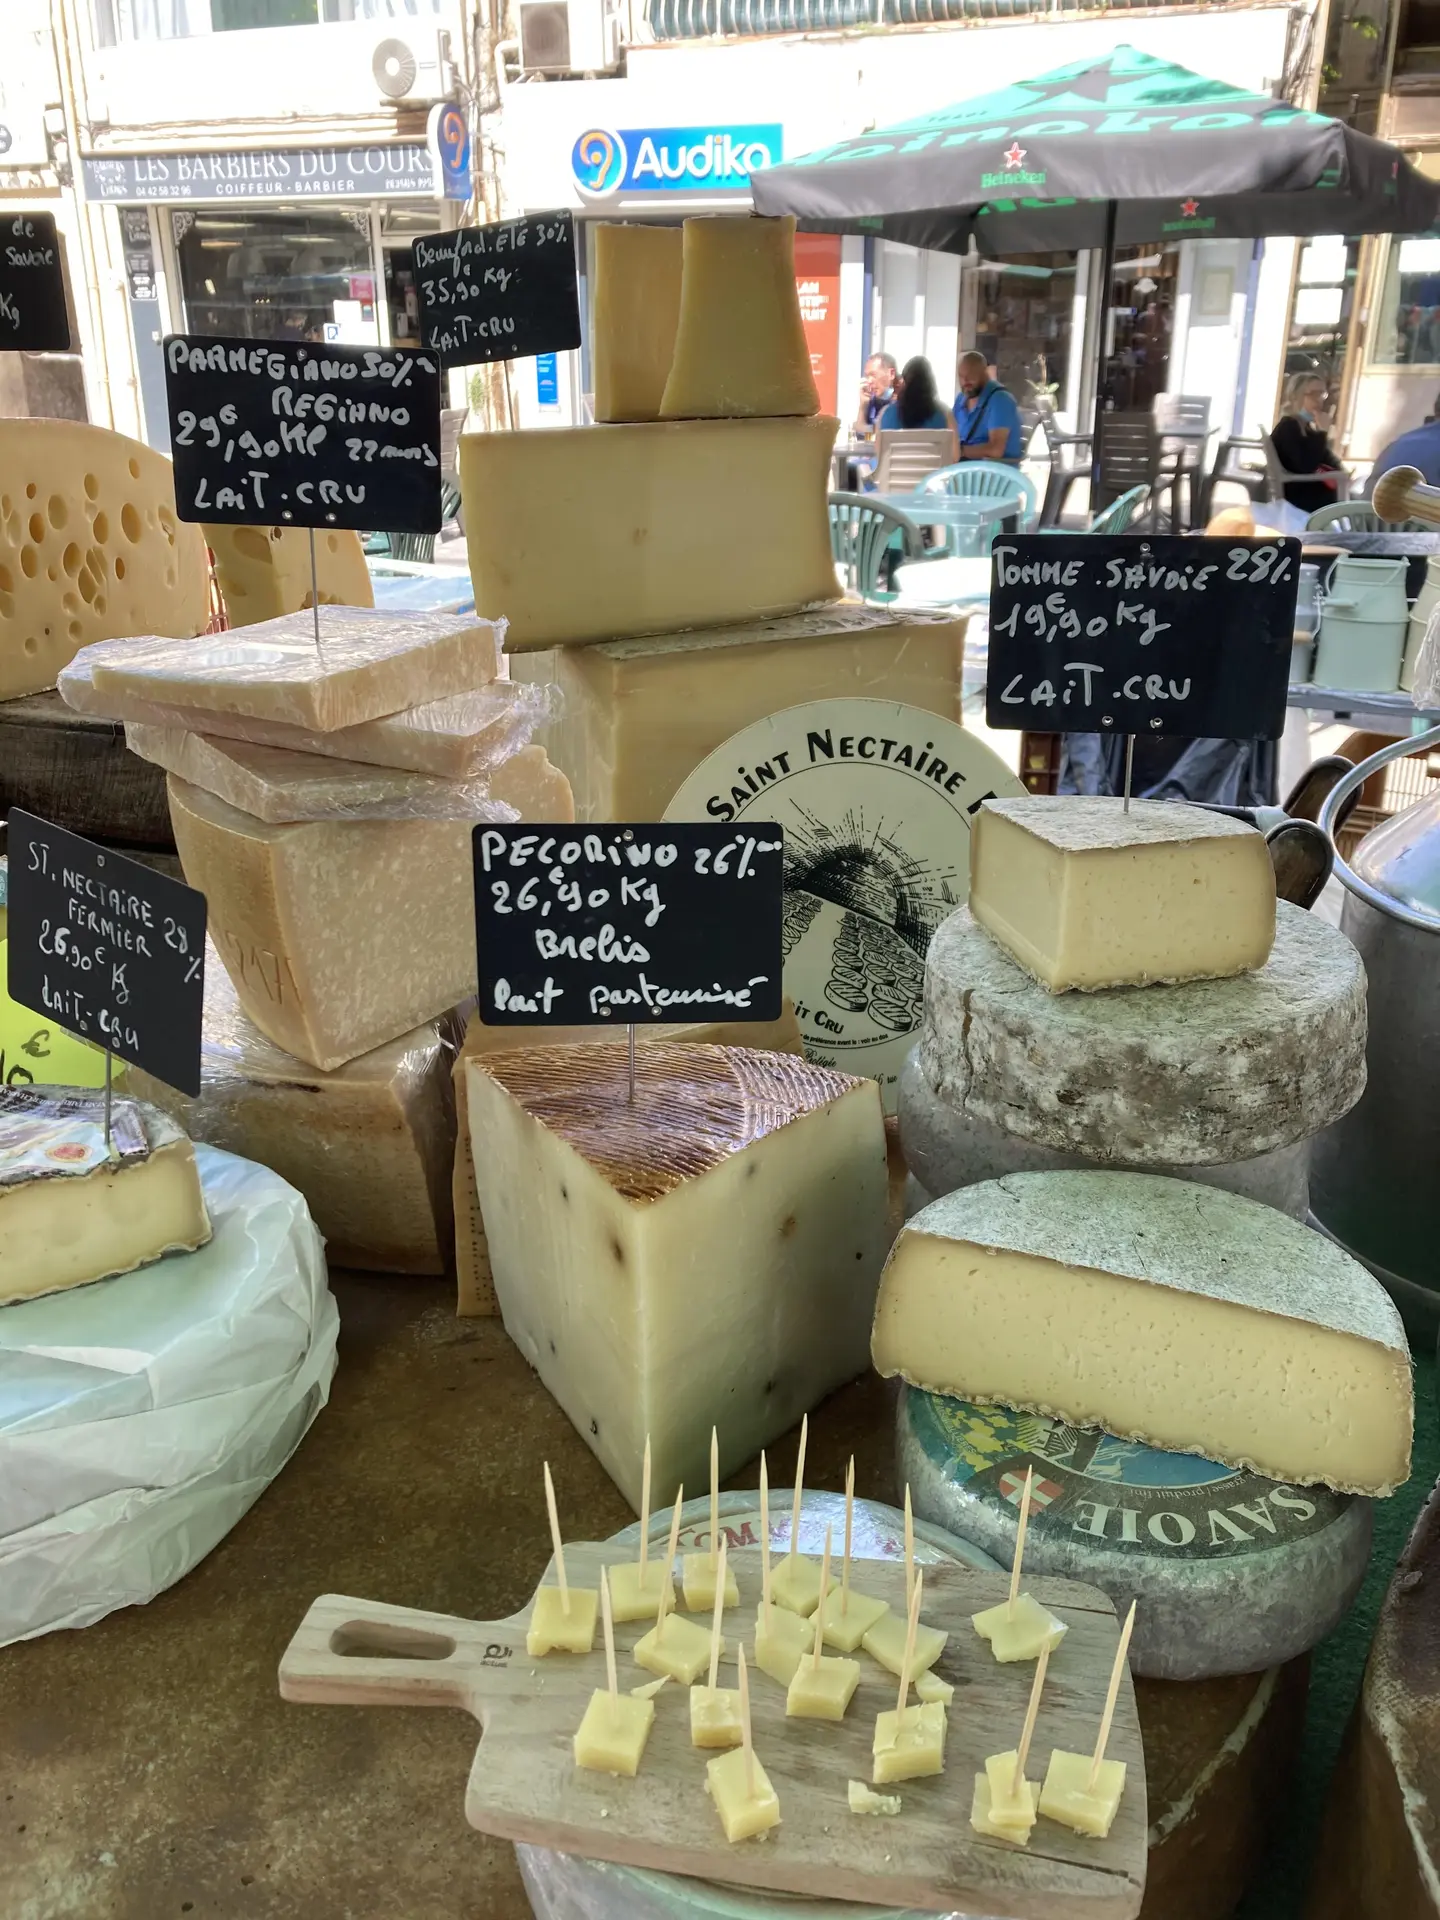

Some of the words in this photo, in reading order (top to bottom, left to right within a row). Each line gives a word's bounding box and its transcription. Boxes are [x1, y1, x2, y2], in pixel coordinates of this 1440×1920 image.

[133, 156, 170, 181] LES
[176, 151, 291, 180] BARBIERS
[300, 148, 337, 176] DU
[632, 134, 772, 179] Audika
[215, 181, 284, 195] COIFFEUR
[294, 179, 356, 193] BARBIER
[981, 169, 1046, 188] Heineken
[12, 215, 35, 238] de
[5, 246, 54, 267] Savoie
[992, 545, 1085, 588] TOMME
[1116, 599, 1172, 646] Kg
[620, 875, 667, 928] Kg
[814, 1010, 845, 1034] CRU
[1155, 1487, 1205, 1499] produit
[1211, 1475, 1247, 1493] grasse
[1072, 1484, 1318, 1546] SAVOIE
